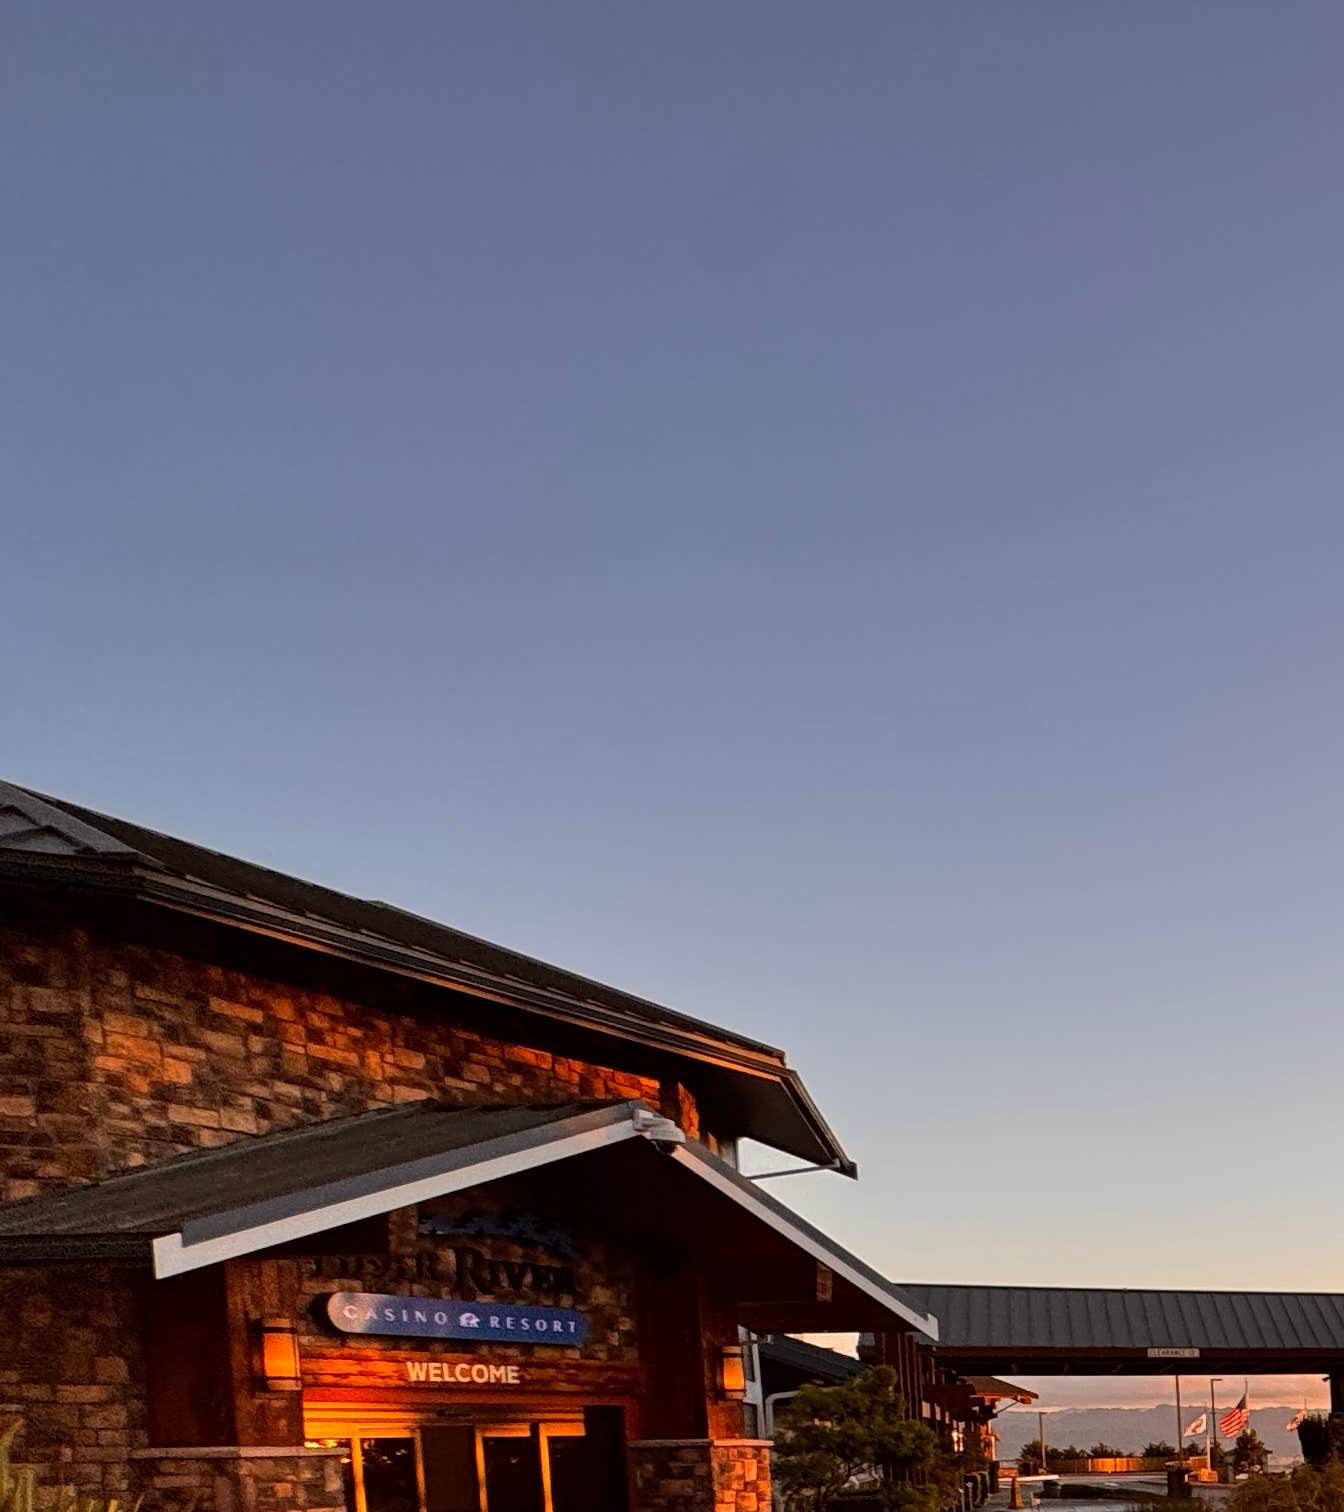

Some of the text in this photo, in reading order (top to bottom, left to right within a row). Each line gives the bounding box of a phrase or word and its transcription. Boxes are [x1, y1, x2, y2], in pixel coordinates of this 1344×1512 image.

[343, 1305, 576, 1333] CASINO RESORT
[407, 1361, 521, 1384] WELCOME
